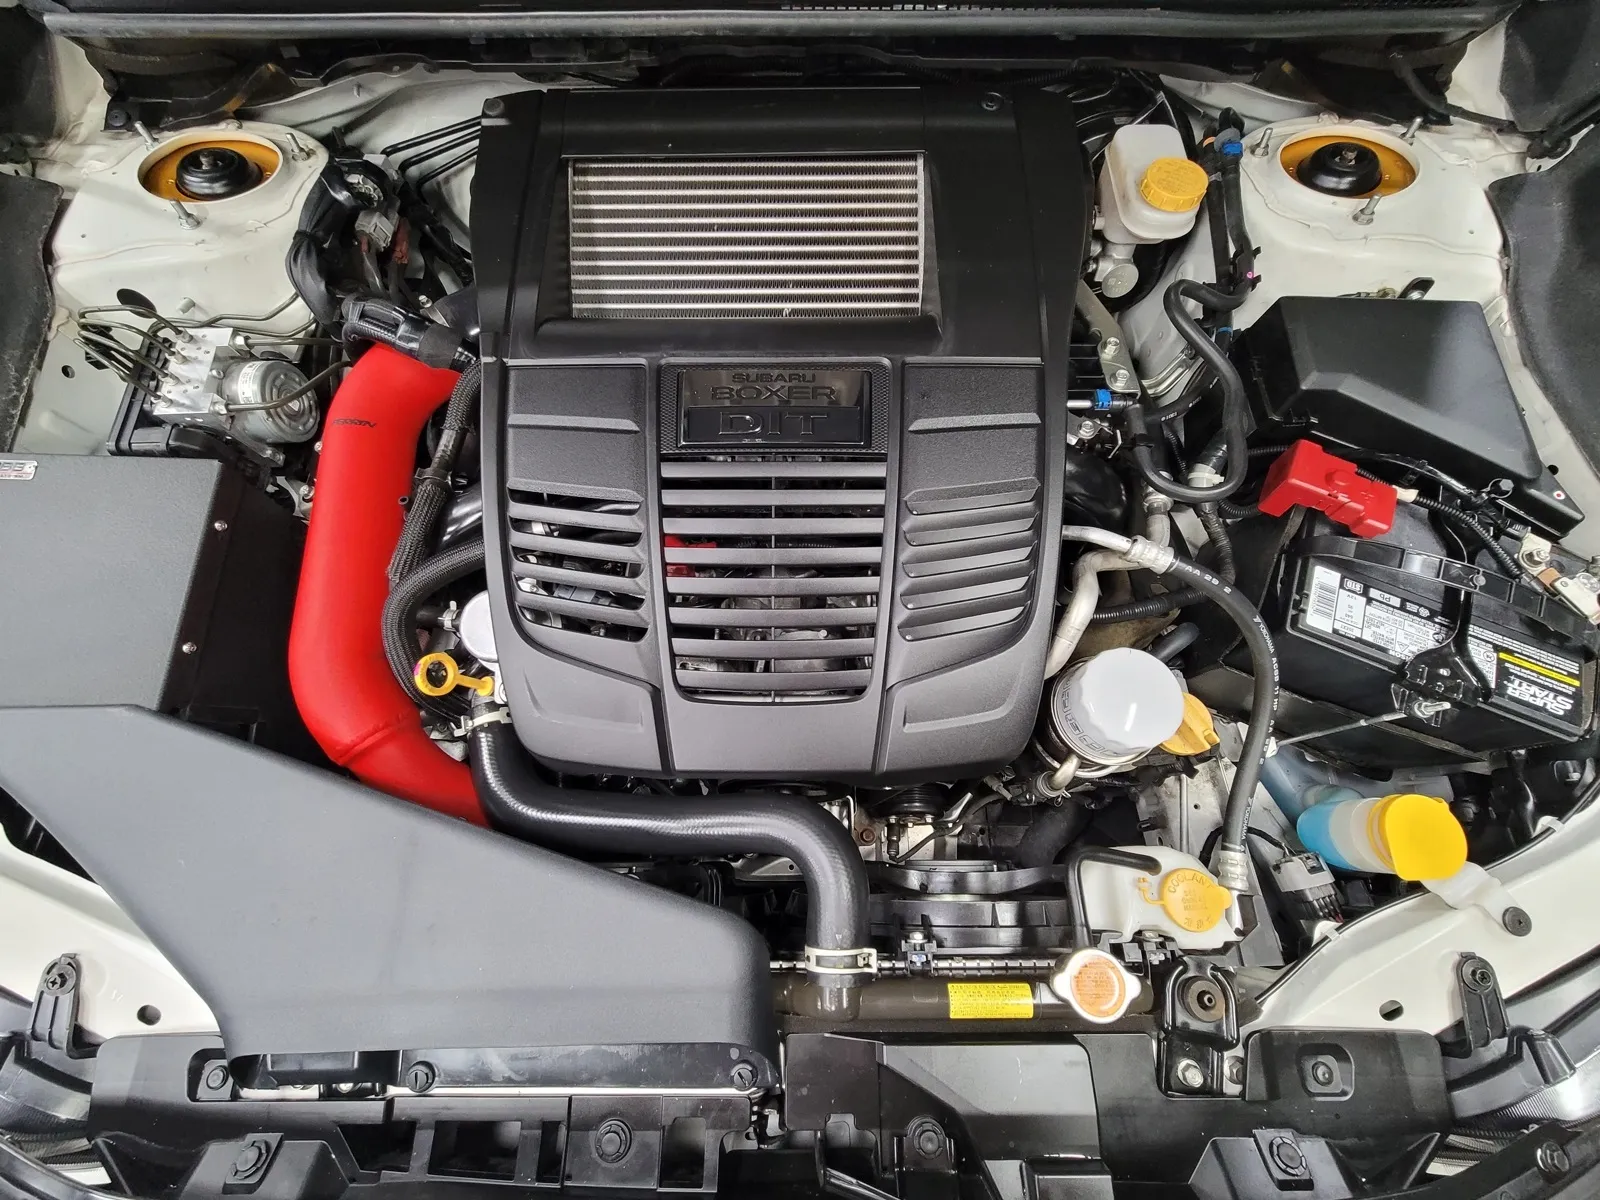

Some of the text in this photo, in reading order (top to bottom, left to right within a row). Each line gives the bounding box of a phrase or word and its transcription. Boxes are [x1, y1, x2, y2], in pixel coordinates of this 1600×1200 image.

[731, 373, 817, 383] SUBARU
[711, 385, 837, 401] BOXER
[718, 411, 828, 435] DIT
[1185, 565, 1201, 576] AA
[1379, 593, 1391, 602] Pb
[1505, 680, 1574, 709] START
[1506, 686, 1565, 715] SUPER
[1241, 807, 1252, 840] YOKOHAMA
[1167, 873, 1215, 893] COOLANT
